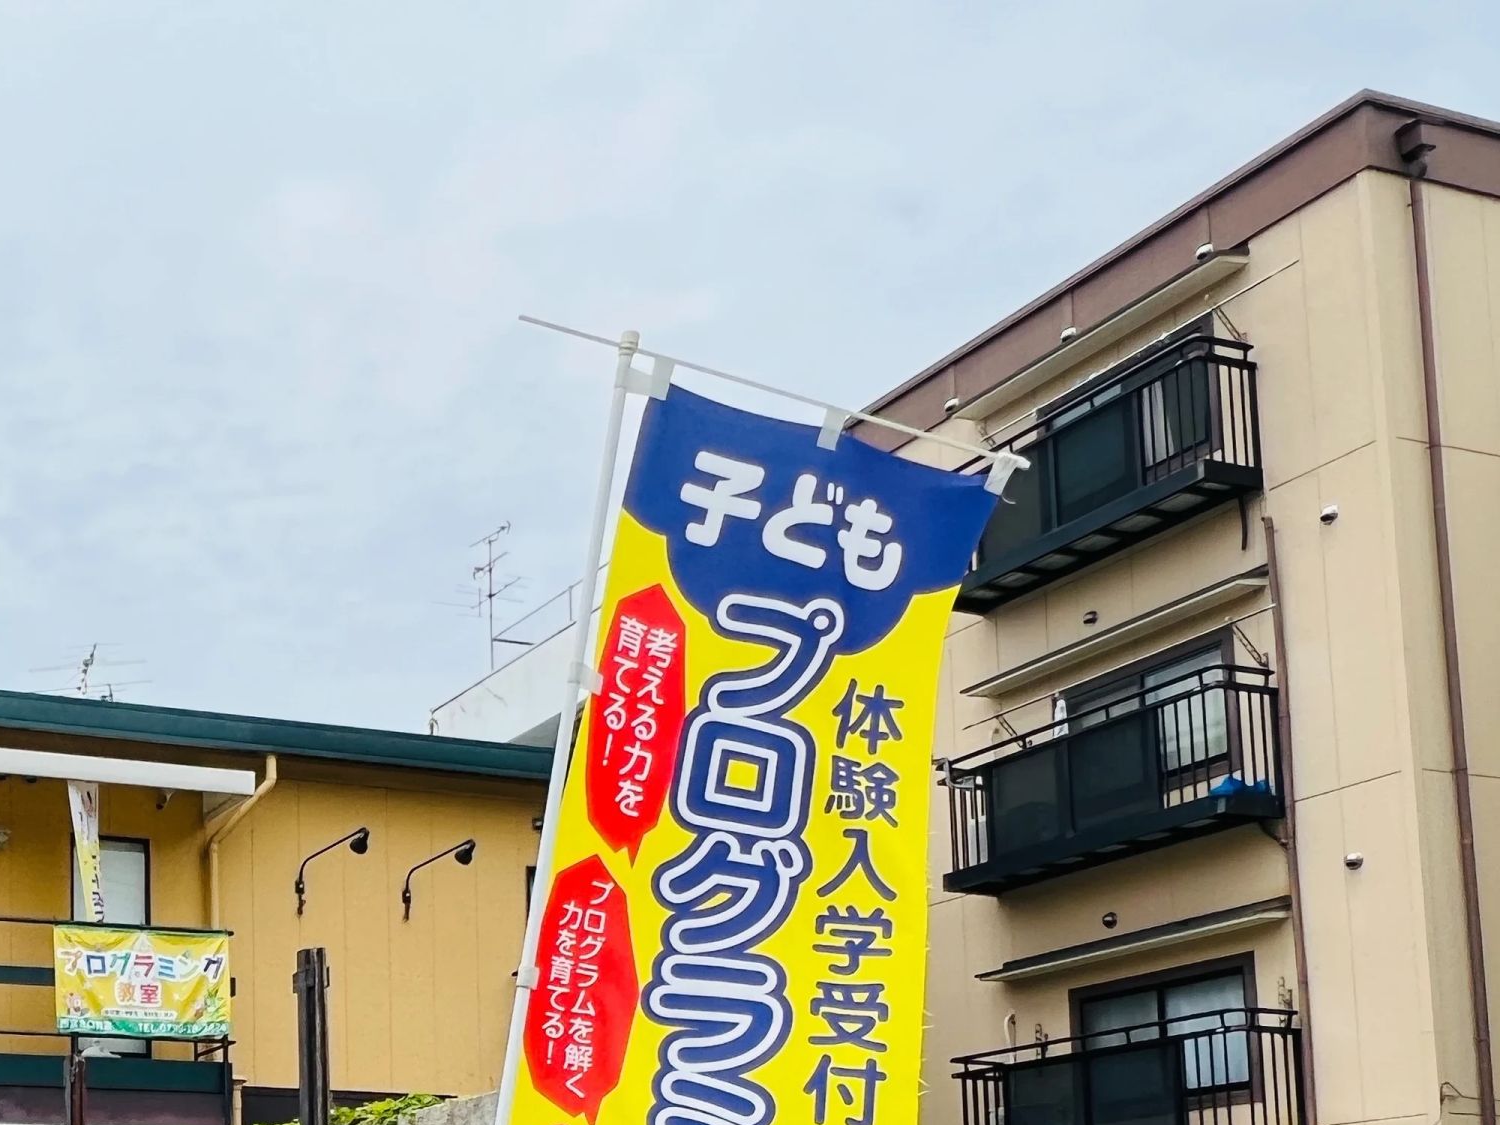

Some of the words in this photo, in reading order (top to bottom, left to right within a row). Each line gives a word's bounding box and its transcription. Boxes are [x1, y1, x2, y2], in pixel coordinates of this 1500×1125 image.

[679, 450, 903, 592] 子ども
[613, 624, 678, 818] 考える力を
[58, 949, 225, 981] プログラミング
[118, 982, 160, 1005] 教室
[563, 880, 614, 1099] プログラムを解く
